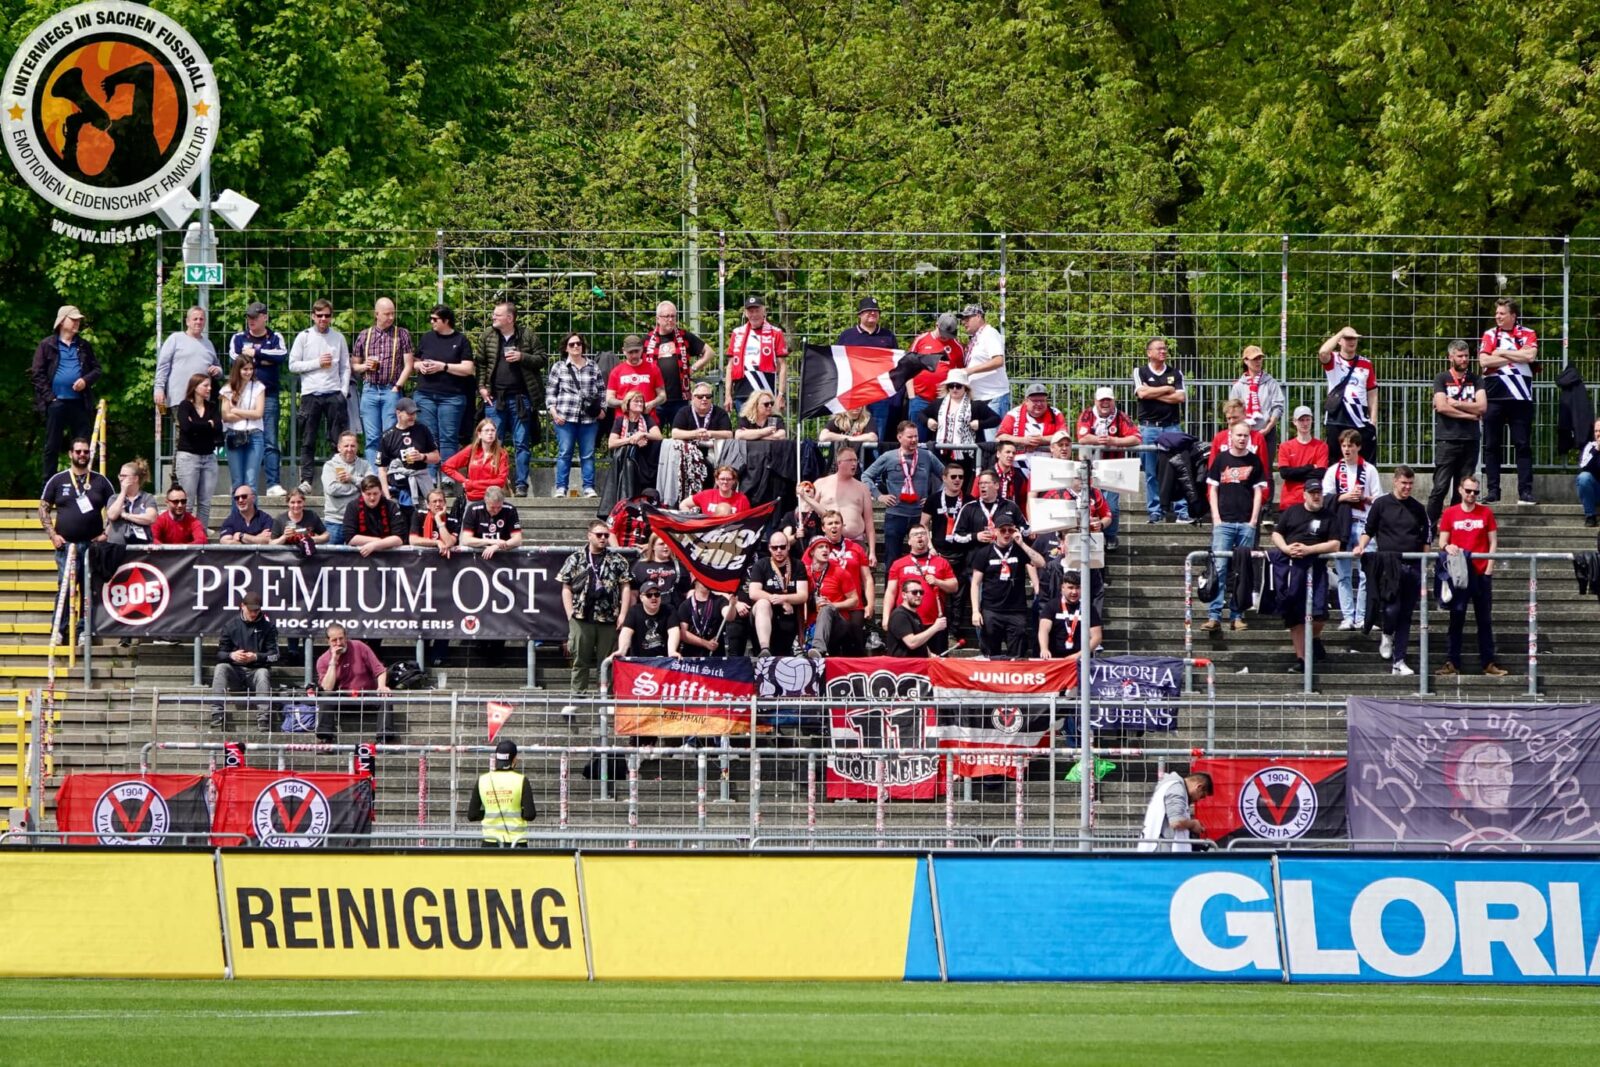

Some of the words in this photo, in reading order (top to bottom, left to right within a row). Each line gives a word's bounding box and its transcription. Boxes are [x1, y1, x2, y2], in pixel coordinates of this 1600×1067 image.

[111, 580, 161, 607] 805
[192, 564, 437, 613] PREMIUM
[452, 566, 548, 614] OST
[275, 618, 308, 629] HOC
[362, 619, 419, 630] VICTOR
[422, 620, 455, 630] ERIS
[701, 664, 725, 677] Sick
[968, 671, 1047, 686] JUNIORS
[1088, 664, 1177, 689] VIKTORIA
[826, 669, 935, 702] BLOCK
[845, 707, 926, 750] 11
[1088, 706, 1174, 728] QUEENS
[284, 784, 304, 795] 1904
[1267, 773, 1290, 783] 1904
[121, 787, 144, 797] 1904
[1245, 798, 1290, 837] VIKTORIA
[235, 886, 573, 951] REINIGUNG
[1169, 871, 1600, 978] GLORI
